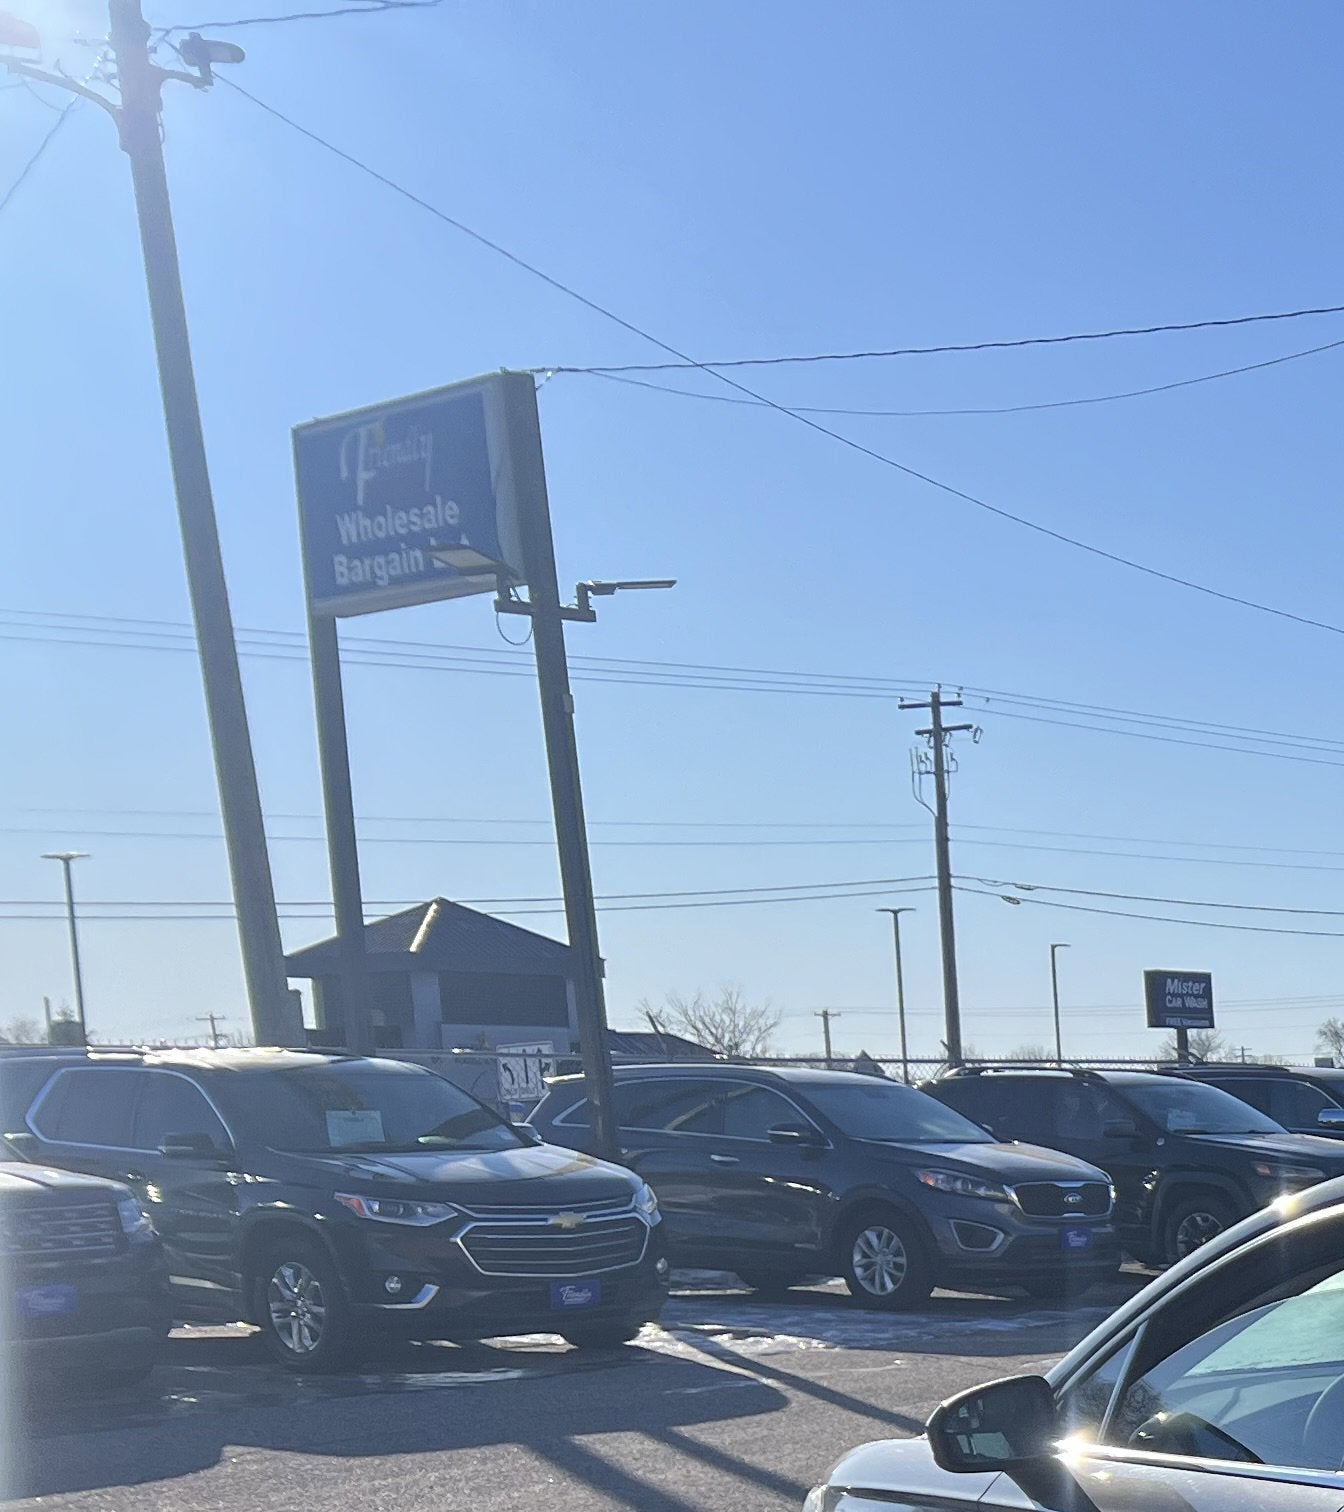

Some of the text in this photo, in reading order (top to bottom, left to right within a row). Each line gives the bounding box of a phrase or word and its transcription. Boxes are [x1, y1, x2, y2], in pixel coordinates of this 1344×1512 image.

[336, 495, 460, 545] Wholesale
[333, 543, 425, 586] Bargain
[1165, 978, 1206, 994] Mister
